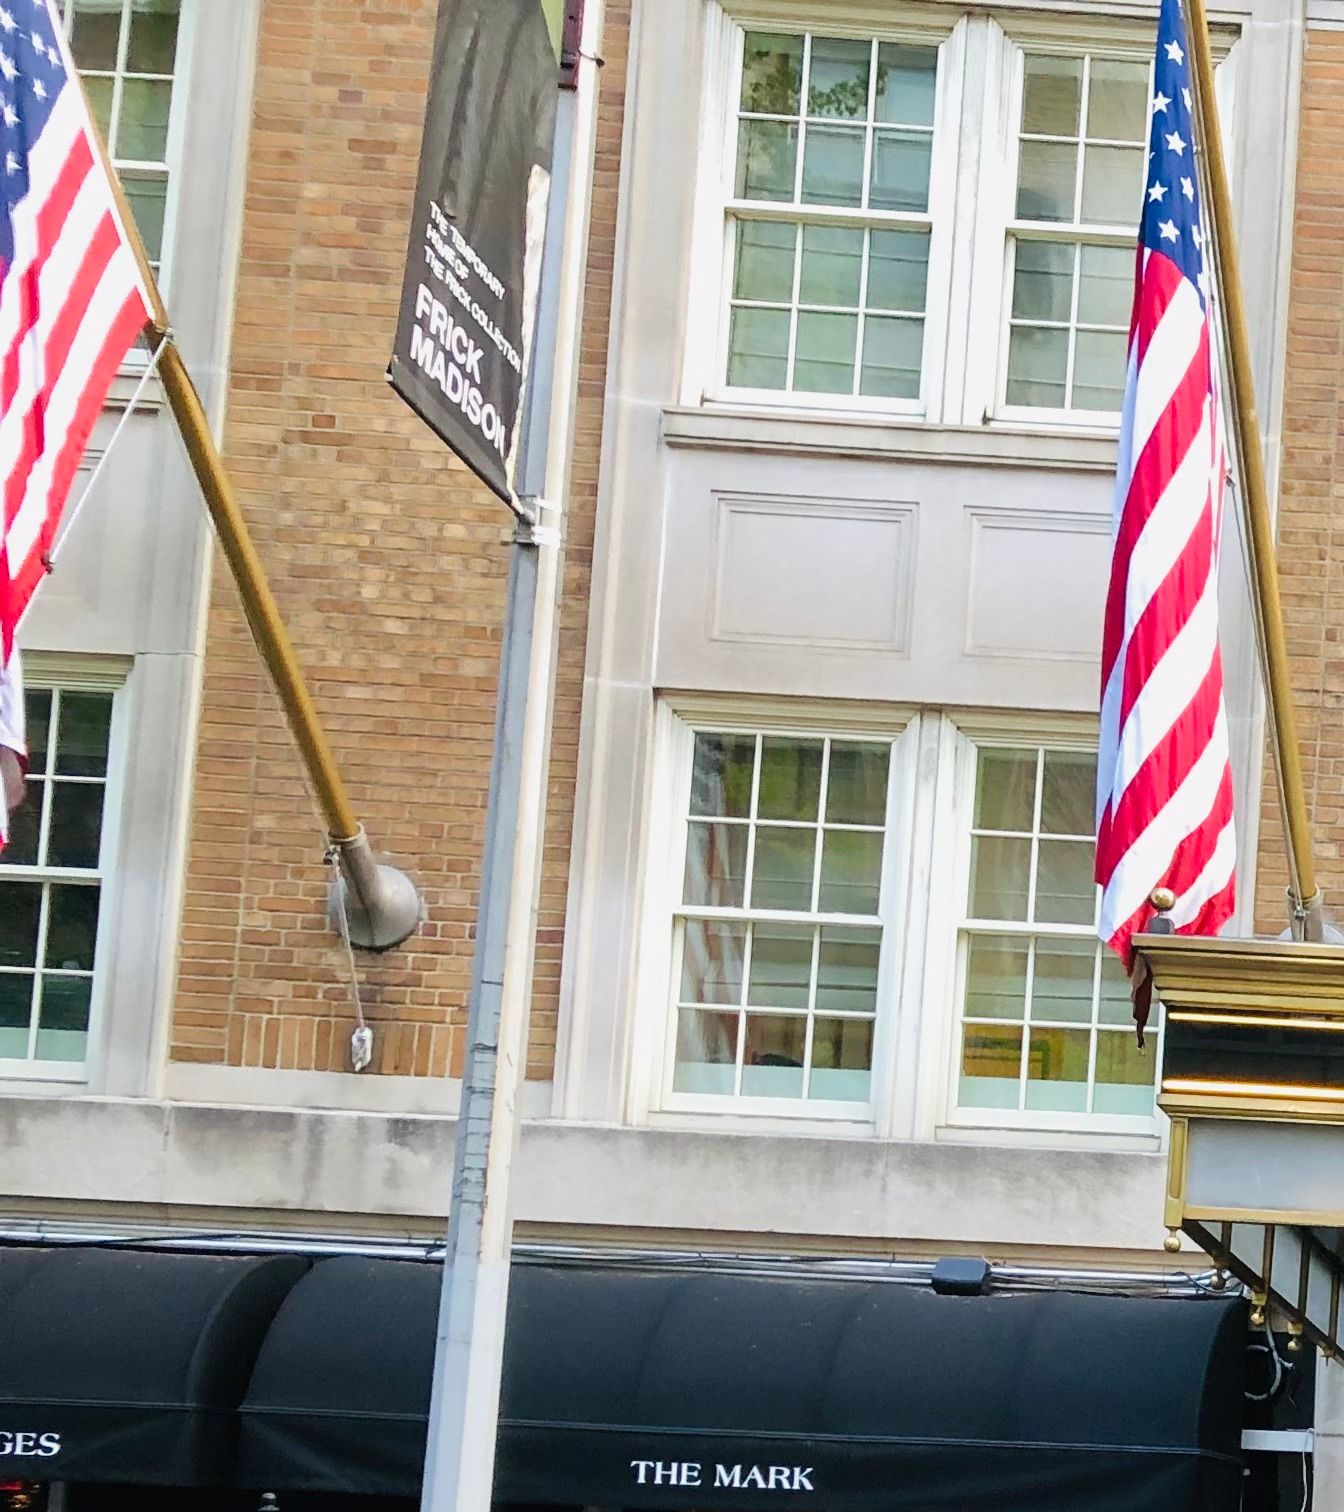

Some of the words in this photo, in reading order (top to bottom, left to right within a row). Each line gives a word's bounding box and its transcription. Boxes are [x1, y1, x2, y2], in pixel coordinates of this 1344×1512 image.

[426, 223, 456, 266] HOME
[454, 259, 470, 280] OF
[430, 200, 449, 236] THE
[450, 225, 506, 300] TEMPORARY
[416, 283, 484, 384] FRICK
[424, 245, 445, 281] THE
[445, 270, 472, 312] FRICK
[471, 303, 521, 374] COLLECTION
[410, 324, 505, 458] MADISON
[630, 1460, 702, 1487] THE
[713, 1464, 815, 1491] MARK
